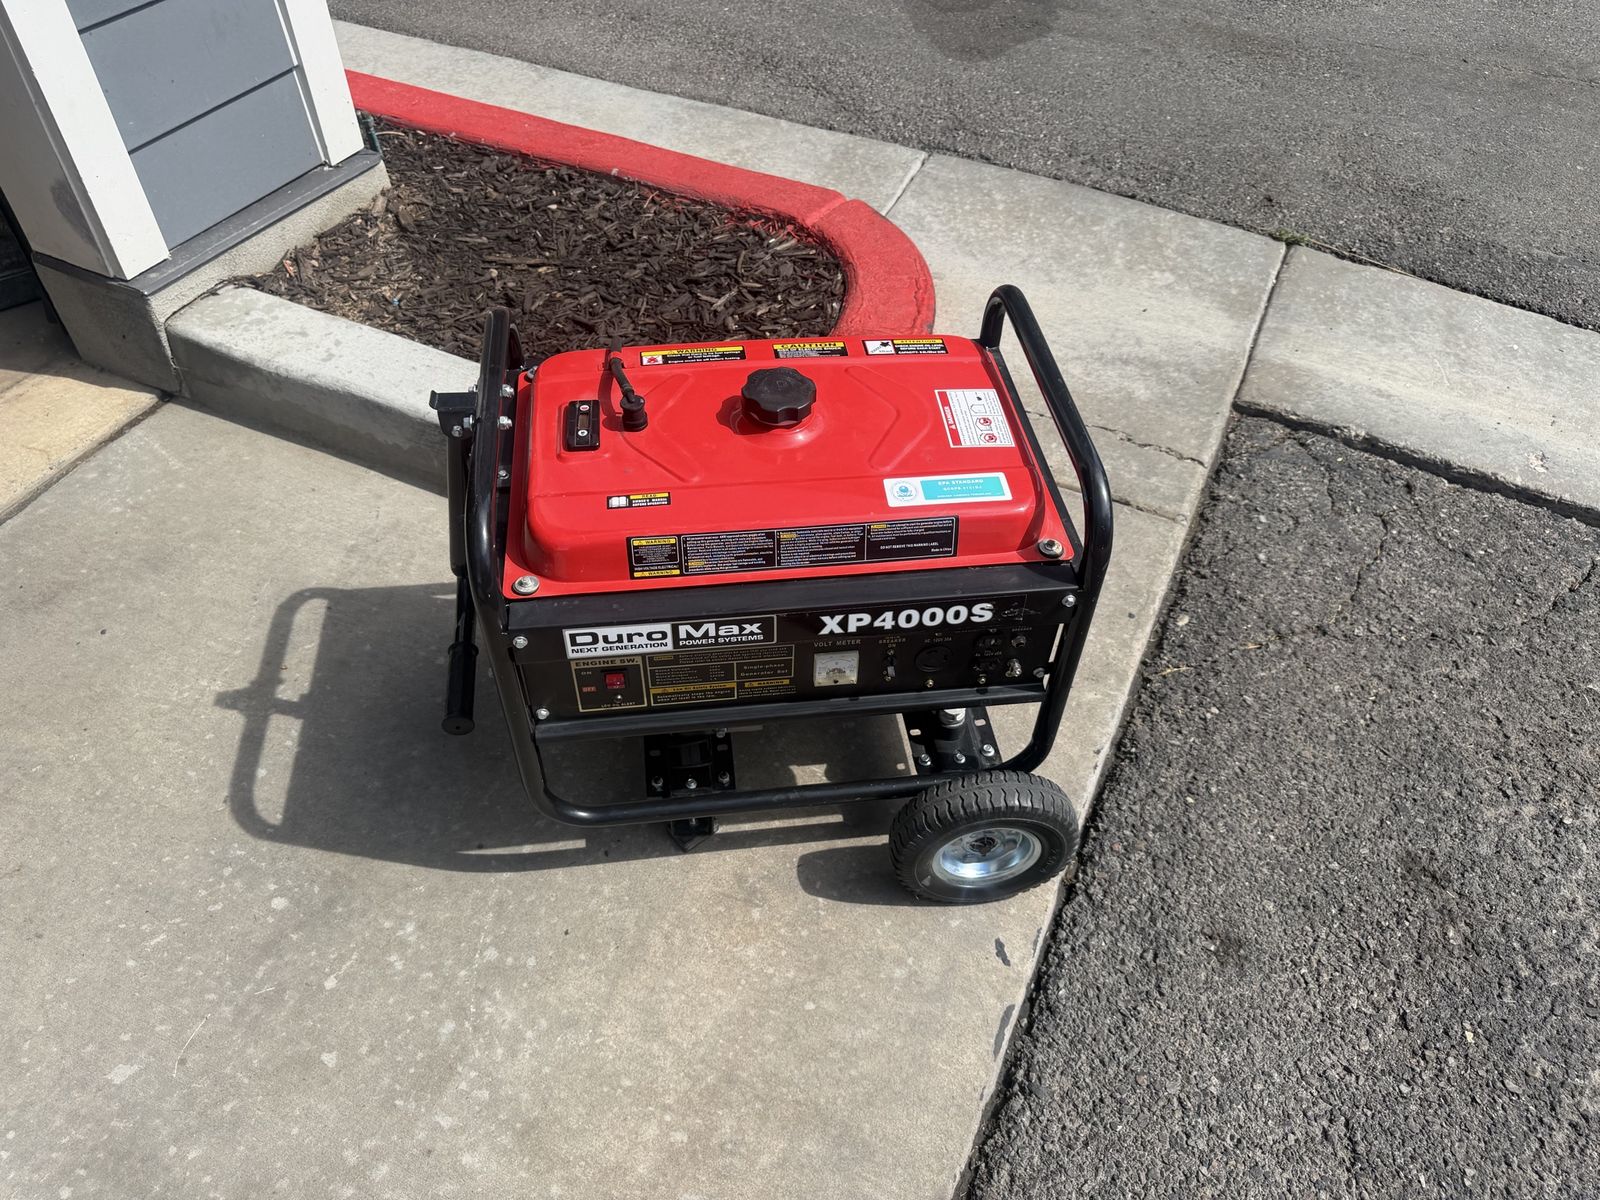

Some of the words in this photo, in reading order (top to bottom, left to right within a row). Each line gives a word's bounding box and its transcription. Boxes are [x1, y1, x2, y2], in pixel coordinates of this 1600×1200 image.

[818, 603, 994, 635] XP4000S
[568, 629, 668, 648] Duro
[678, 622, 764, 639] Max
[679, 638, 715, 646] POWER
[717, 633, 765, 643] SYSTEMS
[571, 646, 600, 654] NEXT
[602, 641, 669, 652] GENERATION
[575, 659, 617, 668] ENGINE
